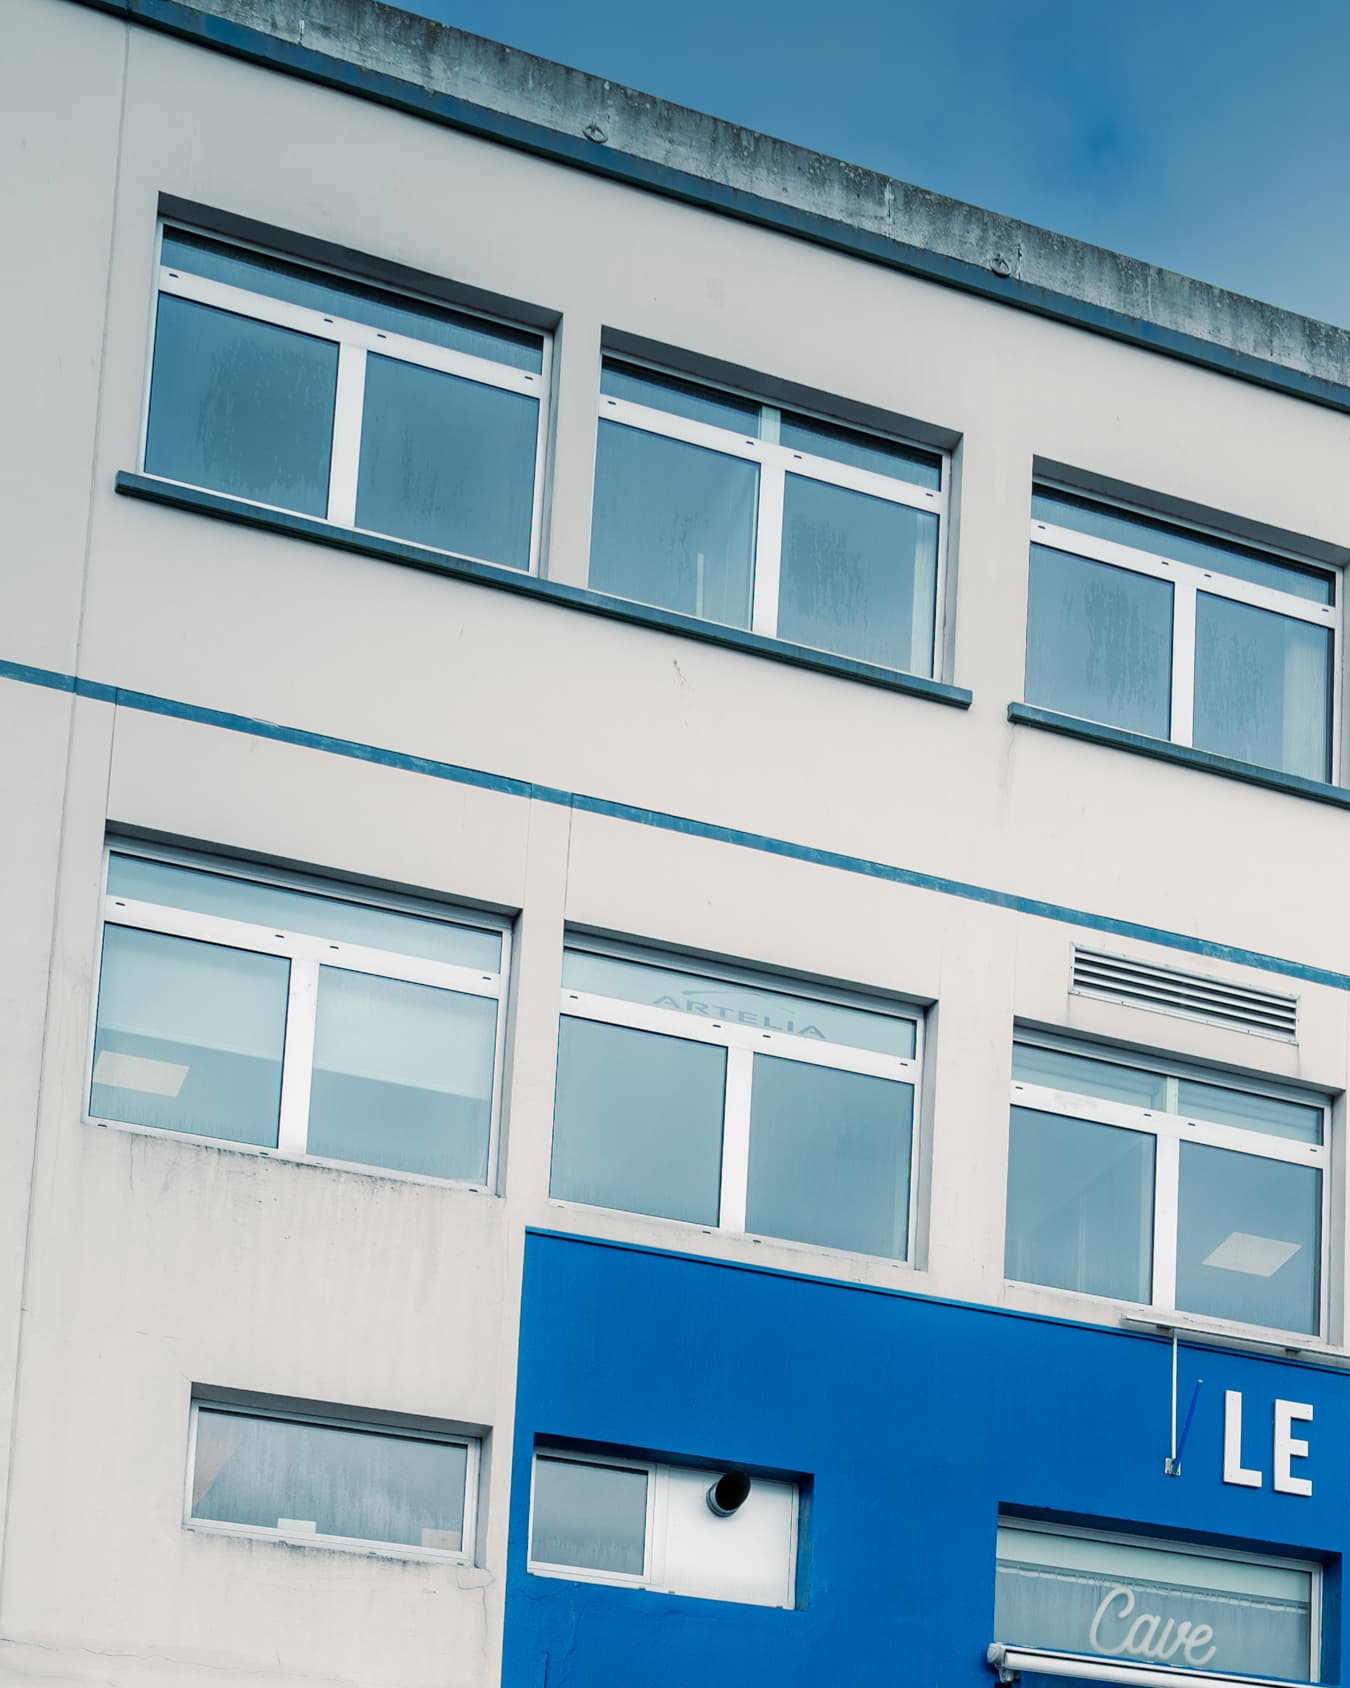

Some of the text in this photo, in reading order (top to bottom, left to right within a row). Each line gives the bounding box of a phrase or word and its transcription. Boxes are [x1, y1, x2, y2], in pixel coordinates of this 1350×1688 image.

[653, 995, 826, 1039] ARTELIA
[1222, 1389, 1314, 1498] LE
[1089, 1587, 1217, 1666] Cave
